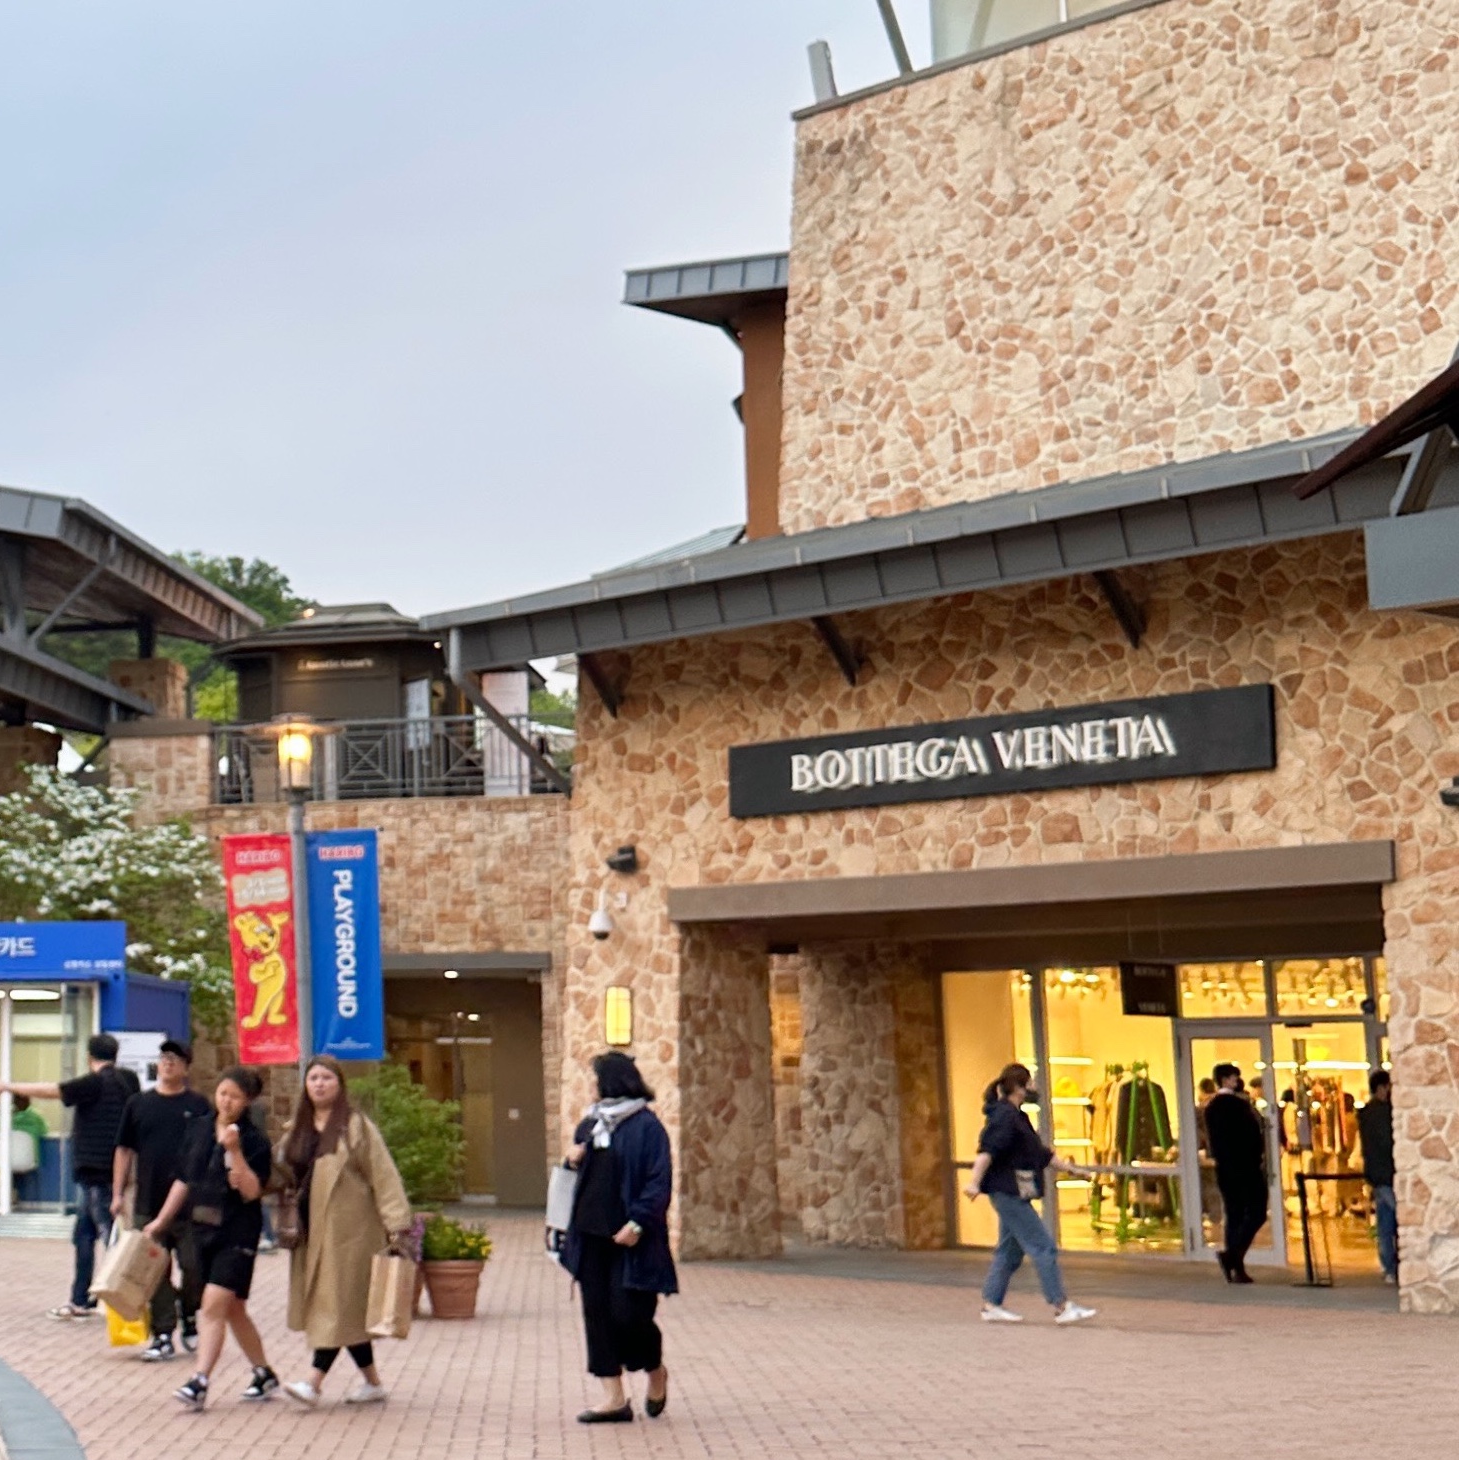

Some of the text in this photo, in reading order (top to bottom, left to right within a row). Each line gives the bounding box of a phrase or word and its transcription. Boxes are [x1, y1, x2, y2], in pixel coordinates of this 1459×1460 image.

[790, 714, 1174, 793] BOTTEGA VENETA
[332, 868, 358, 1019] PLAYGROUND
